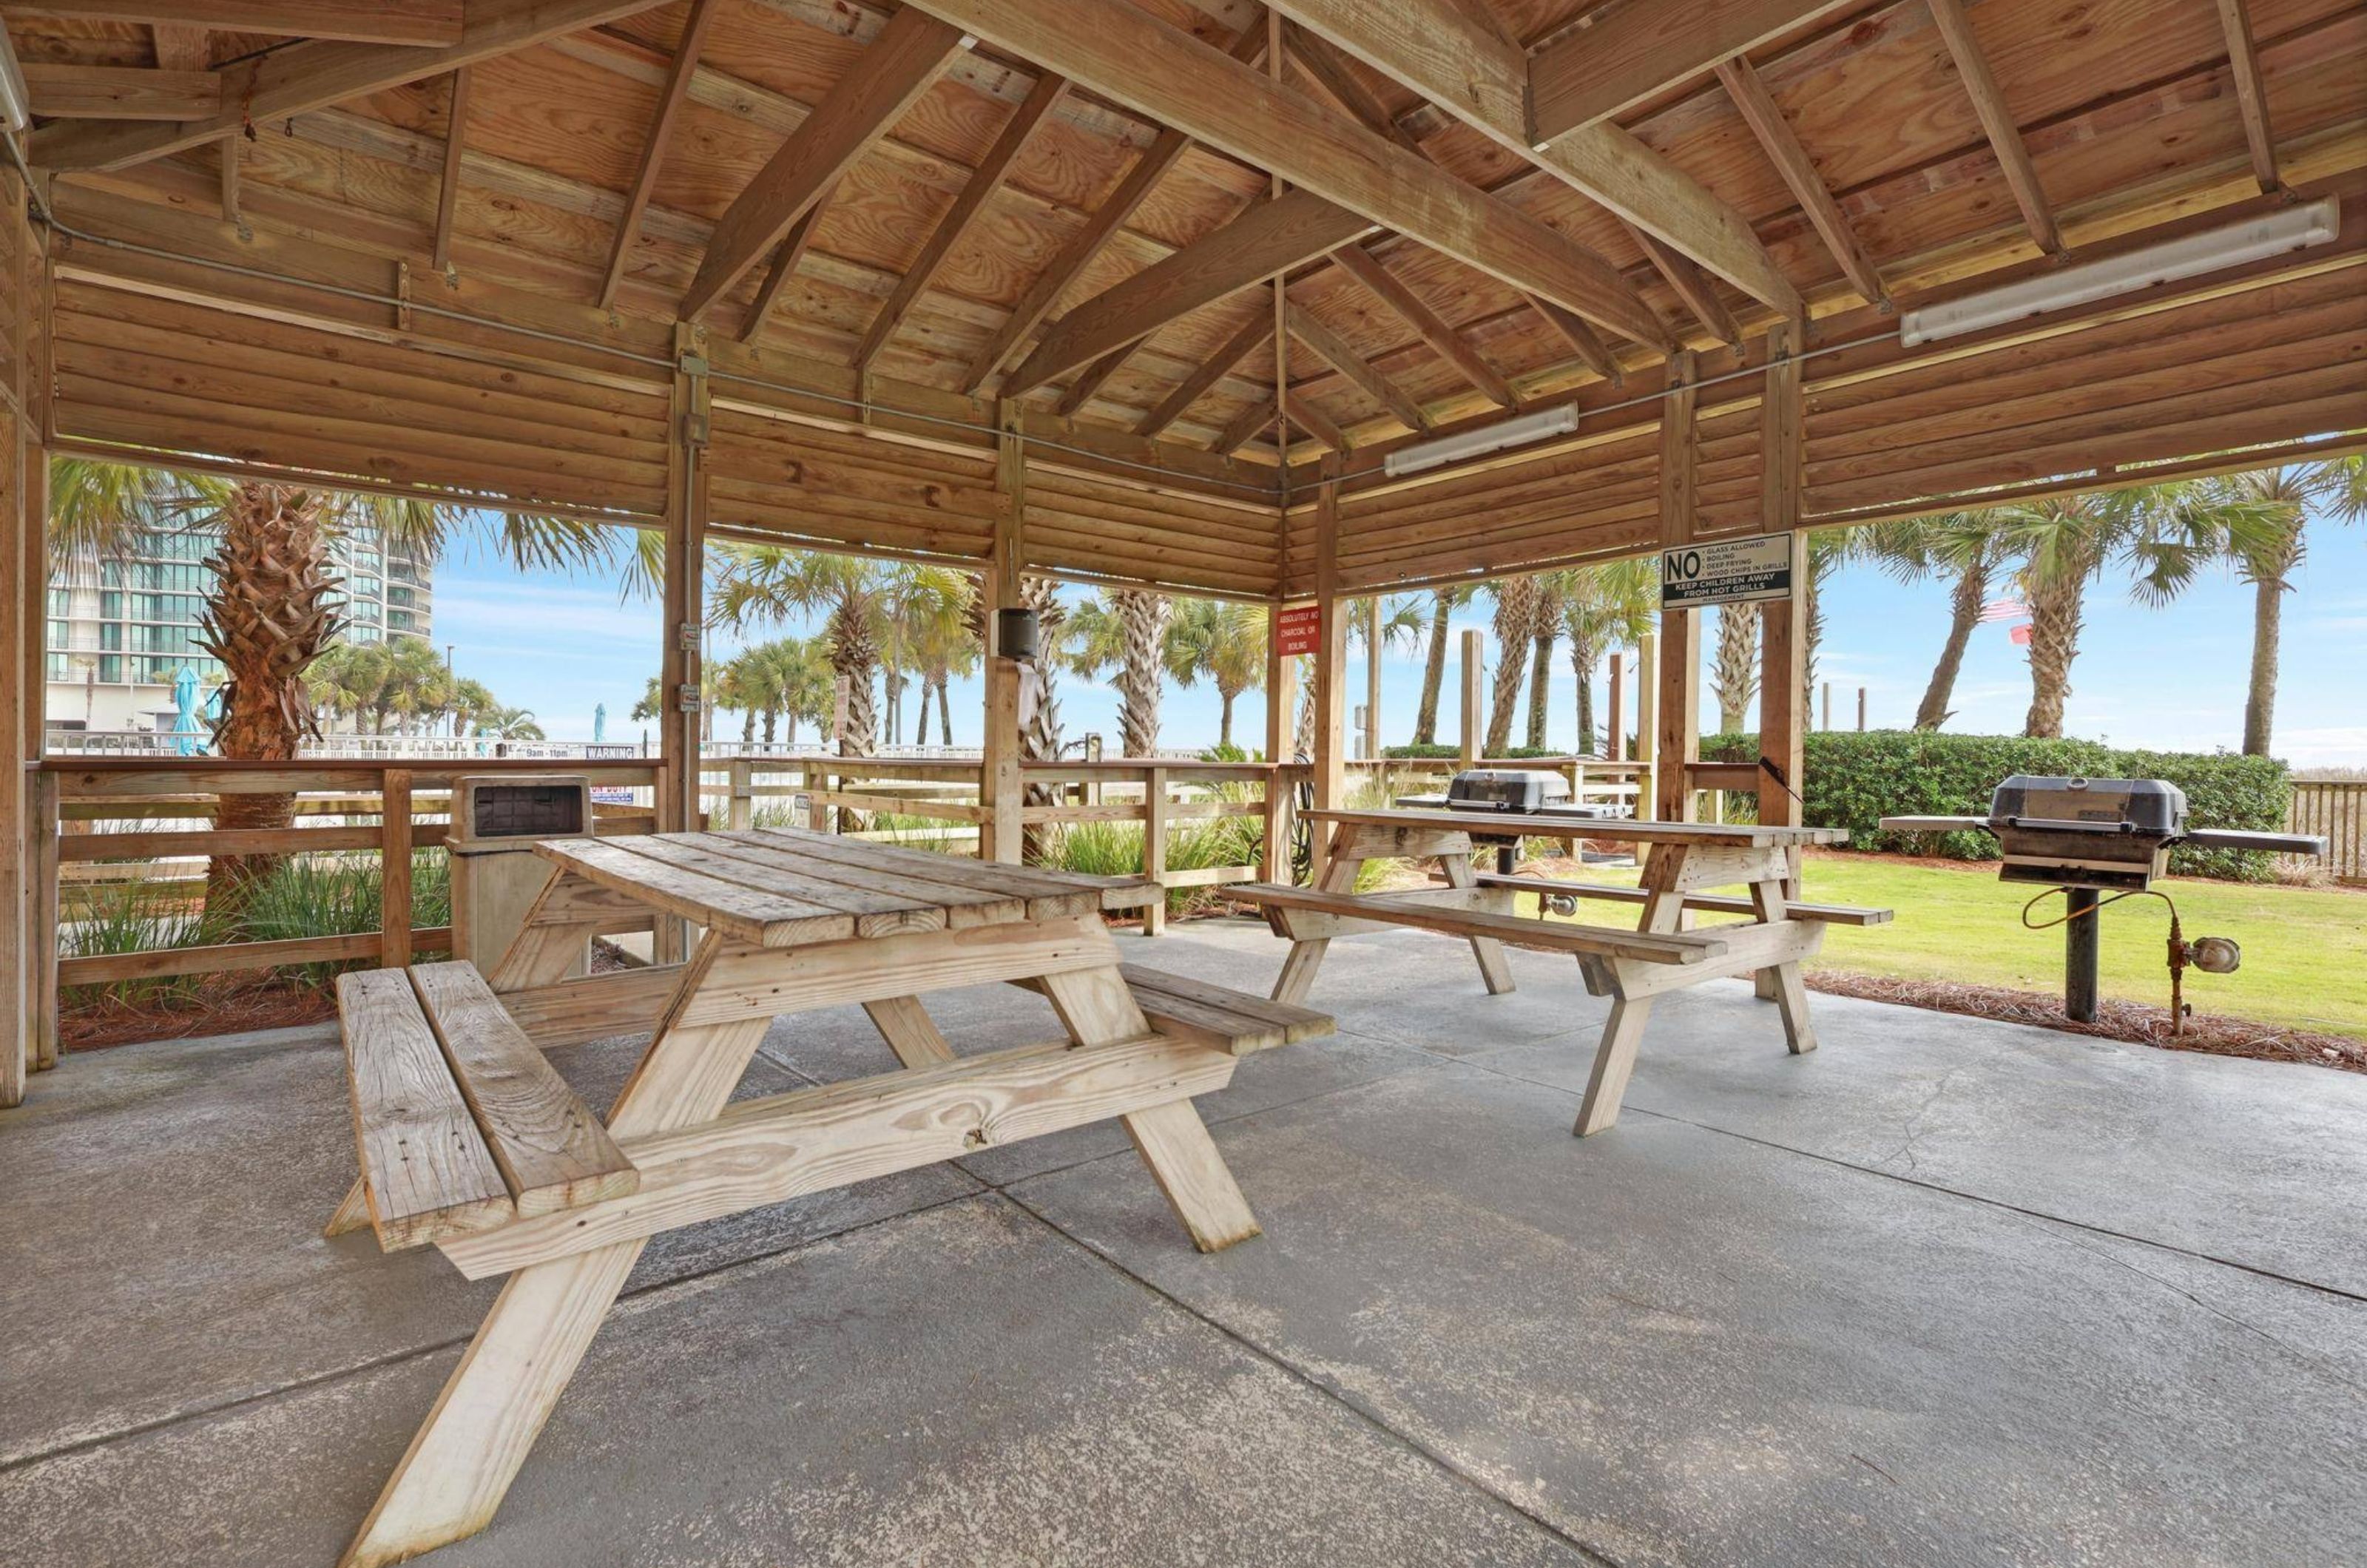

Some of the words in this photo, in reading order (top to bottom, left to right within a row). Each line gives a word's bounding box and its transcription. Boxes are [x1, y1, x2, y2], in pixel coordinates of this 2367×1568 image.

[1706, 546, 1729, 555] GLASS
[1731, 541, 1766, 551] ALLOWED
[1706, 552, 1735, 561] BOILING
[1726, 558, 1752, 567] FRYING
[1667, 551, 1701, 581] NO
[1706, 569, 1729, 577] WOOD
[1731, 566, 1751, 574] CHIPS
[1762, 562, 1788, 570] GRILLS
[1675, 582, 1698, 591] KEEP
[1700, 576, 1745, 588] CHILDREN
[1747, 572, 1775, 583] AWAY
[1684, 589, 1709, 598] FROM
[1711, 586, 1730, 595] HOT
[1733, 582, 1766, 592] GRILLS
[1703, 595, 1744, 603] MANAGEMENT
[1280, 612, 1309, 624] ABSOLUTELY
[1310, 610, 1320, 619] NO
[1280, 627, 1306, 638] CHARCOAL
[1308, 625, 1316, 635] OR
[526, 748, 544, 757] 9am
[550, 749, 568, 758] 11pm
[587, 746, 633, 759] WARNING
